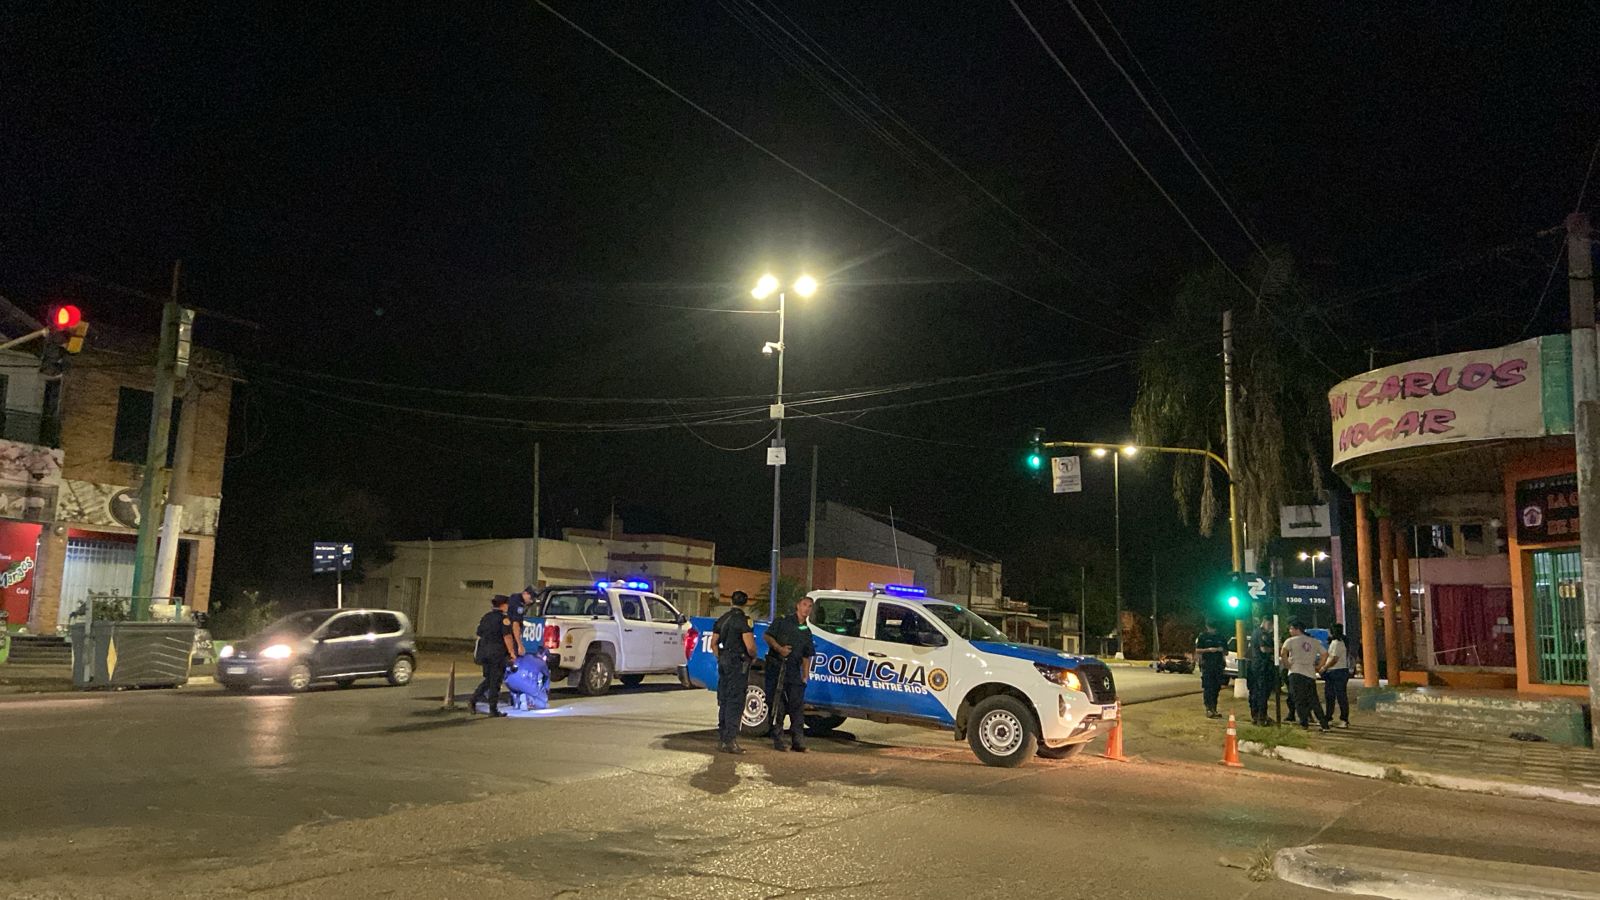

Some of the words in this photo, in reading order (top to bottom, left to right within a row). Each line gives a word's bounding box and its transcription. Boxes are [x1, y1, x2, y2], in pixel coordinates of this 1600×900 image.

[1331, 393, 1348, 422] AN
[1356, 358, 1528, 409] CARLOS
[1339, 409, 1456, 452] HOGAR
[809, 652, 927, 687] POLICIA
[809, 672, 857, 687] PROVINCIA
[858, 679, 871, 689] DE
[872, 681, 903, 693] ENTRE
[904, 683, 928, 695] RIOS
